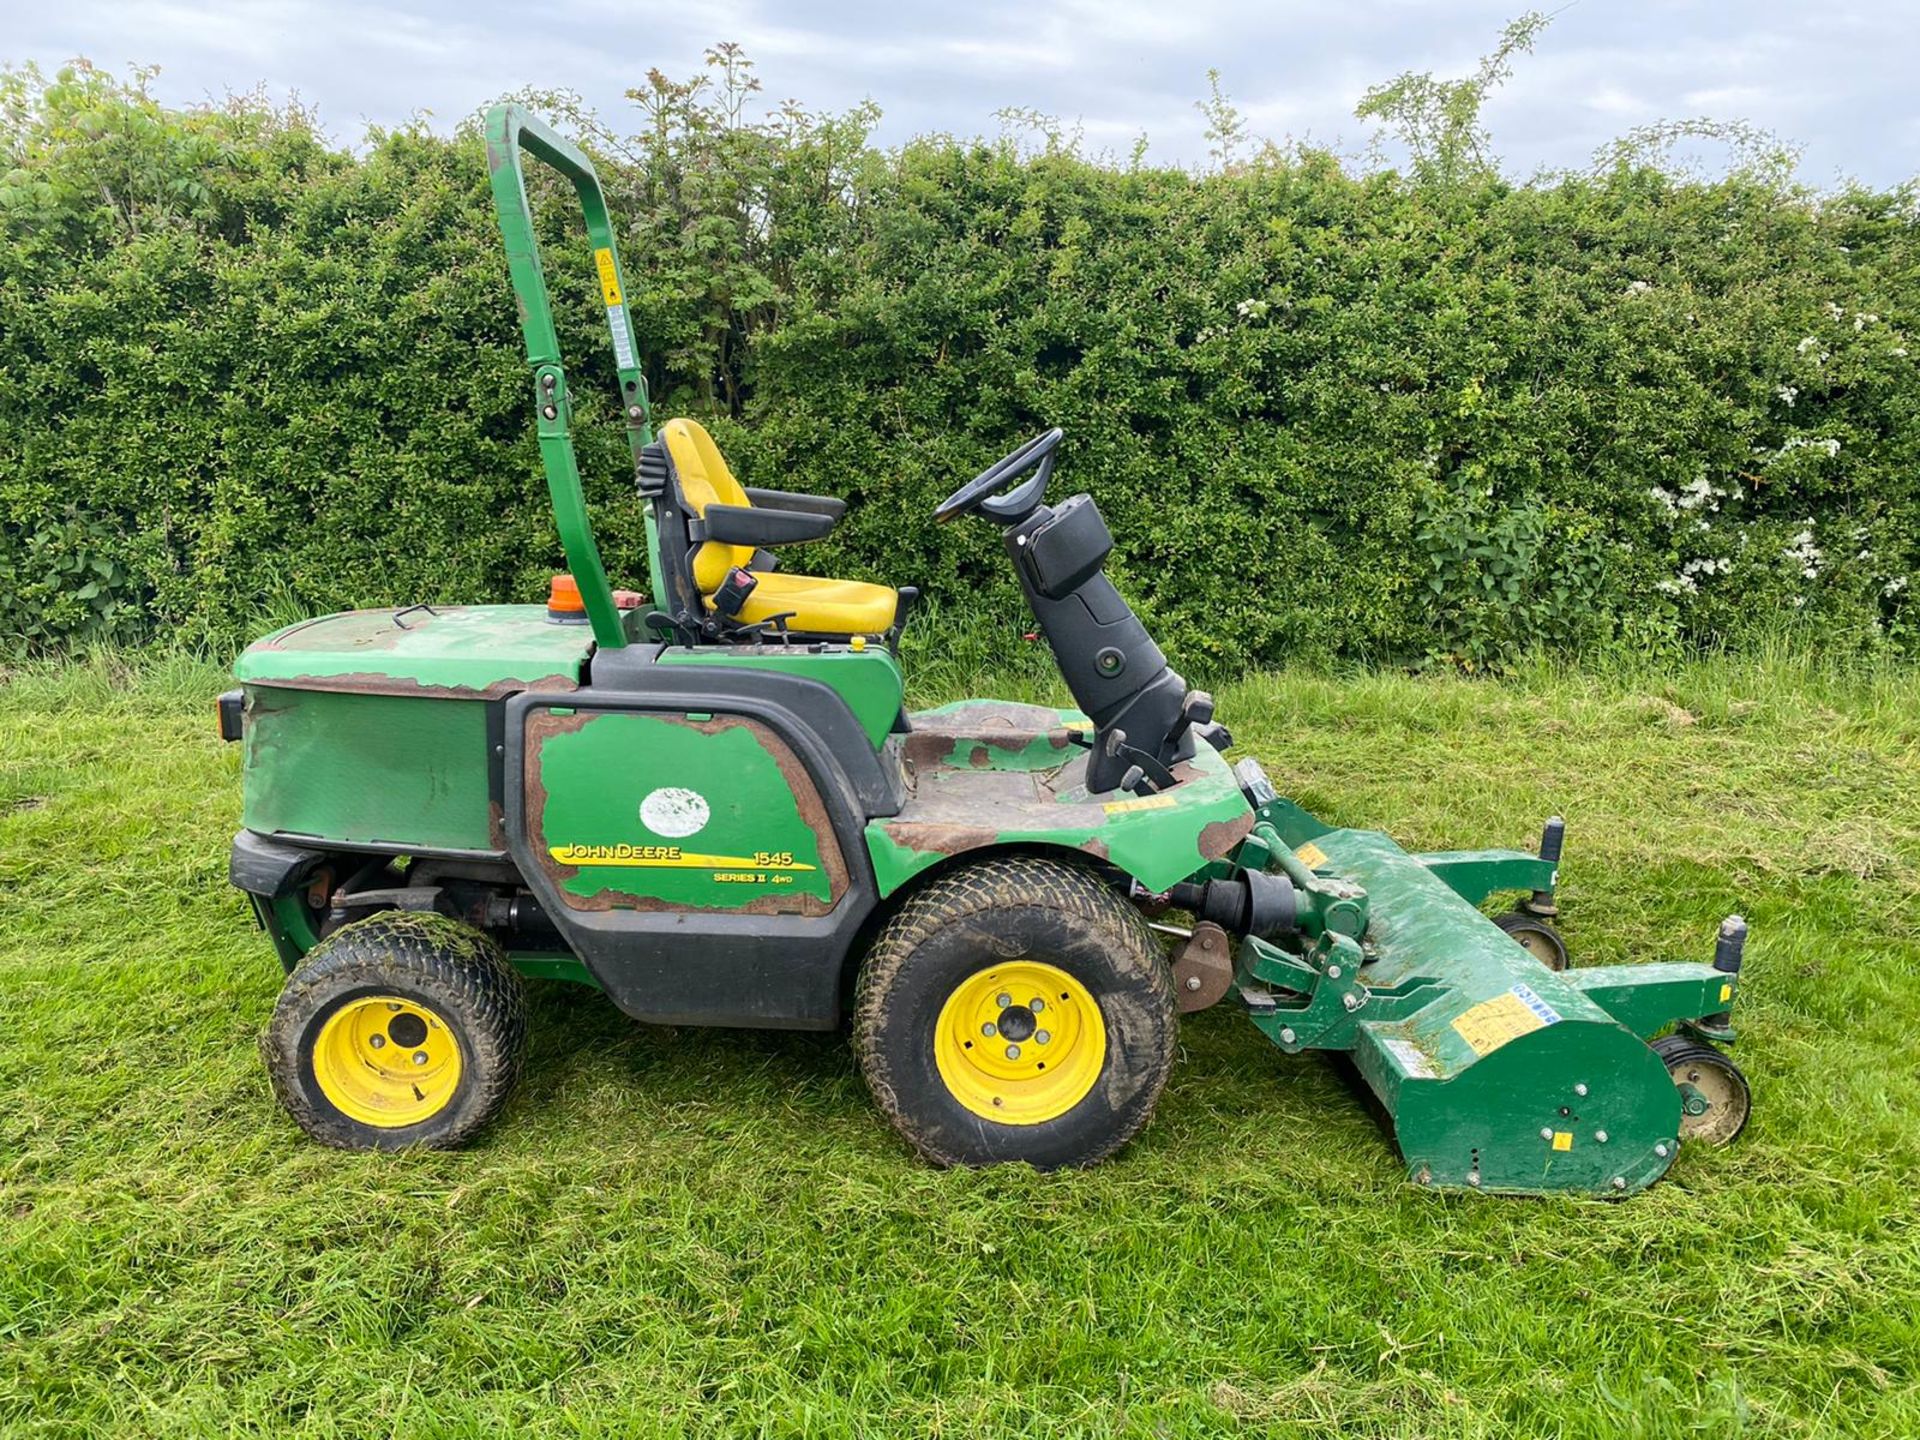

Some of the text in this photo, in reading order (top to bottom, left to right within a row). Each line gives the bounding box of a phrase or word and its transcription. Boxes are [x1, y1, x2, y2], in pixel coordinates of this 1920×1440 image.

[564, 843, 681, 860] JOHN DEERE
[753, 851, 793, 866] 1545
[713, 873, 756, 883] SERIES
[771, 874, 793, 884] 4WD
